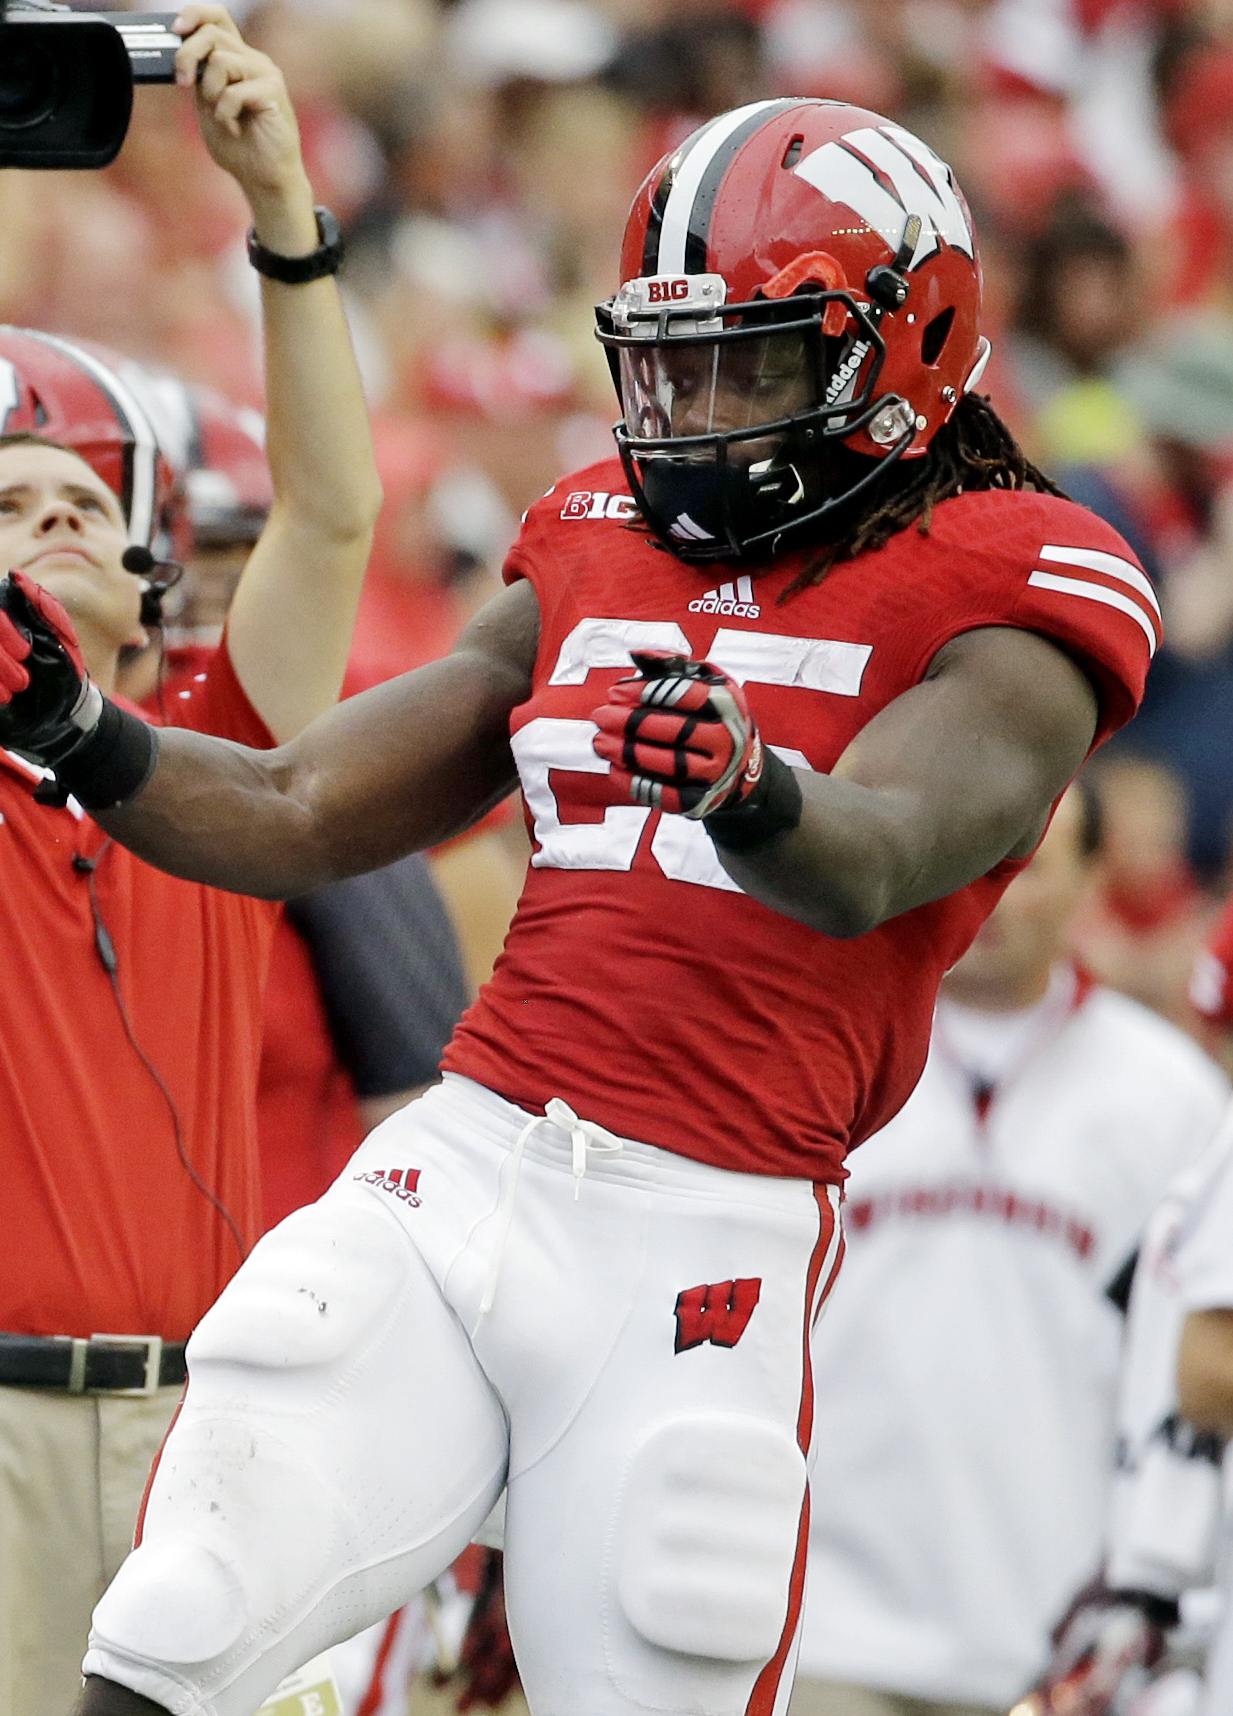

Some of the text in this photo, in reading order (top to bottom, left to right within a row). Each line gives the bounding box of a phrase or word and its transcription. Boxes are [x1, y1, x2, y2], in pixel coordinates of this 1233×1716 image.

[793, 125, 975, 273] W
[688, 597, 761, 619] adidas
[352, 1172, 424, 1208] adidas
[673, 1277, 763, 1356] W
